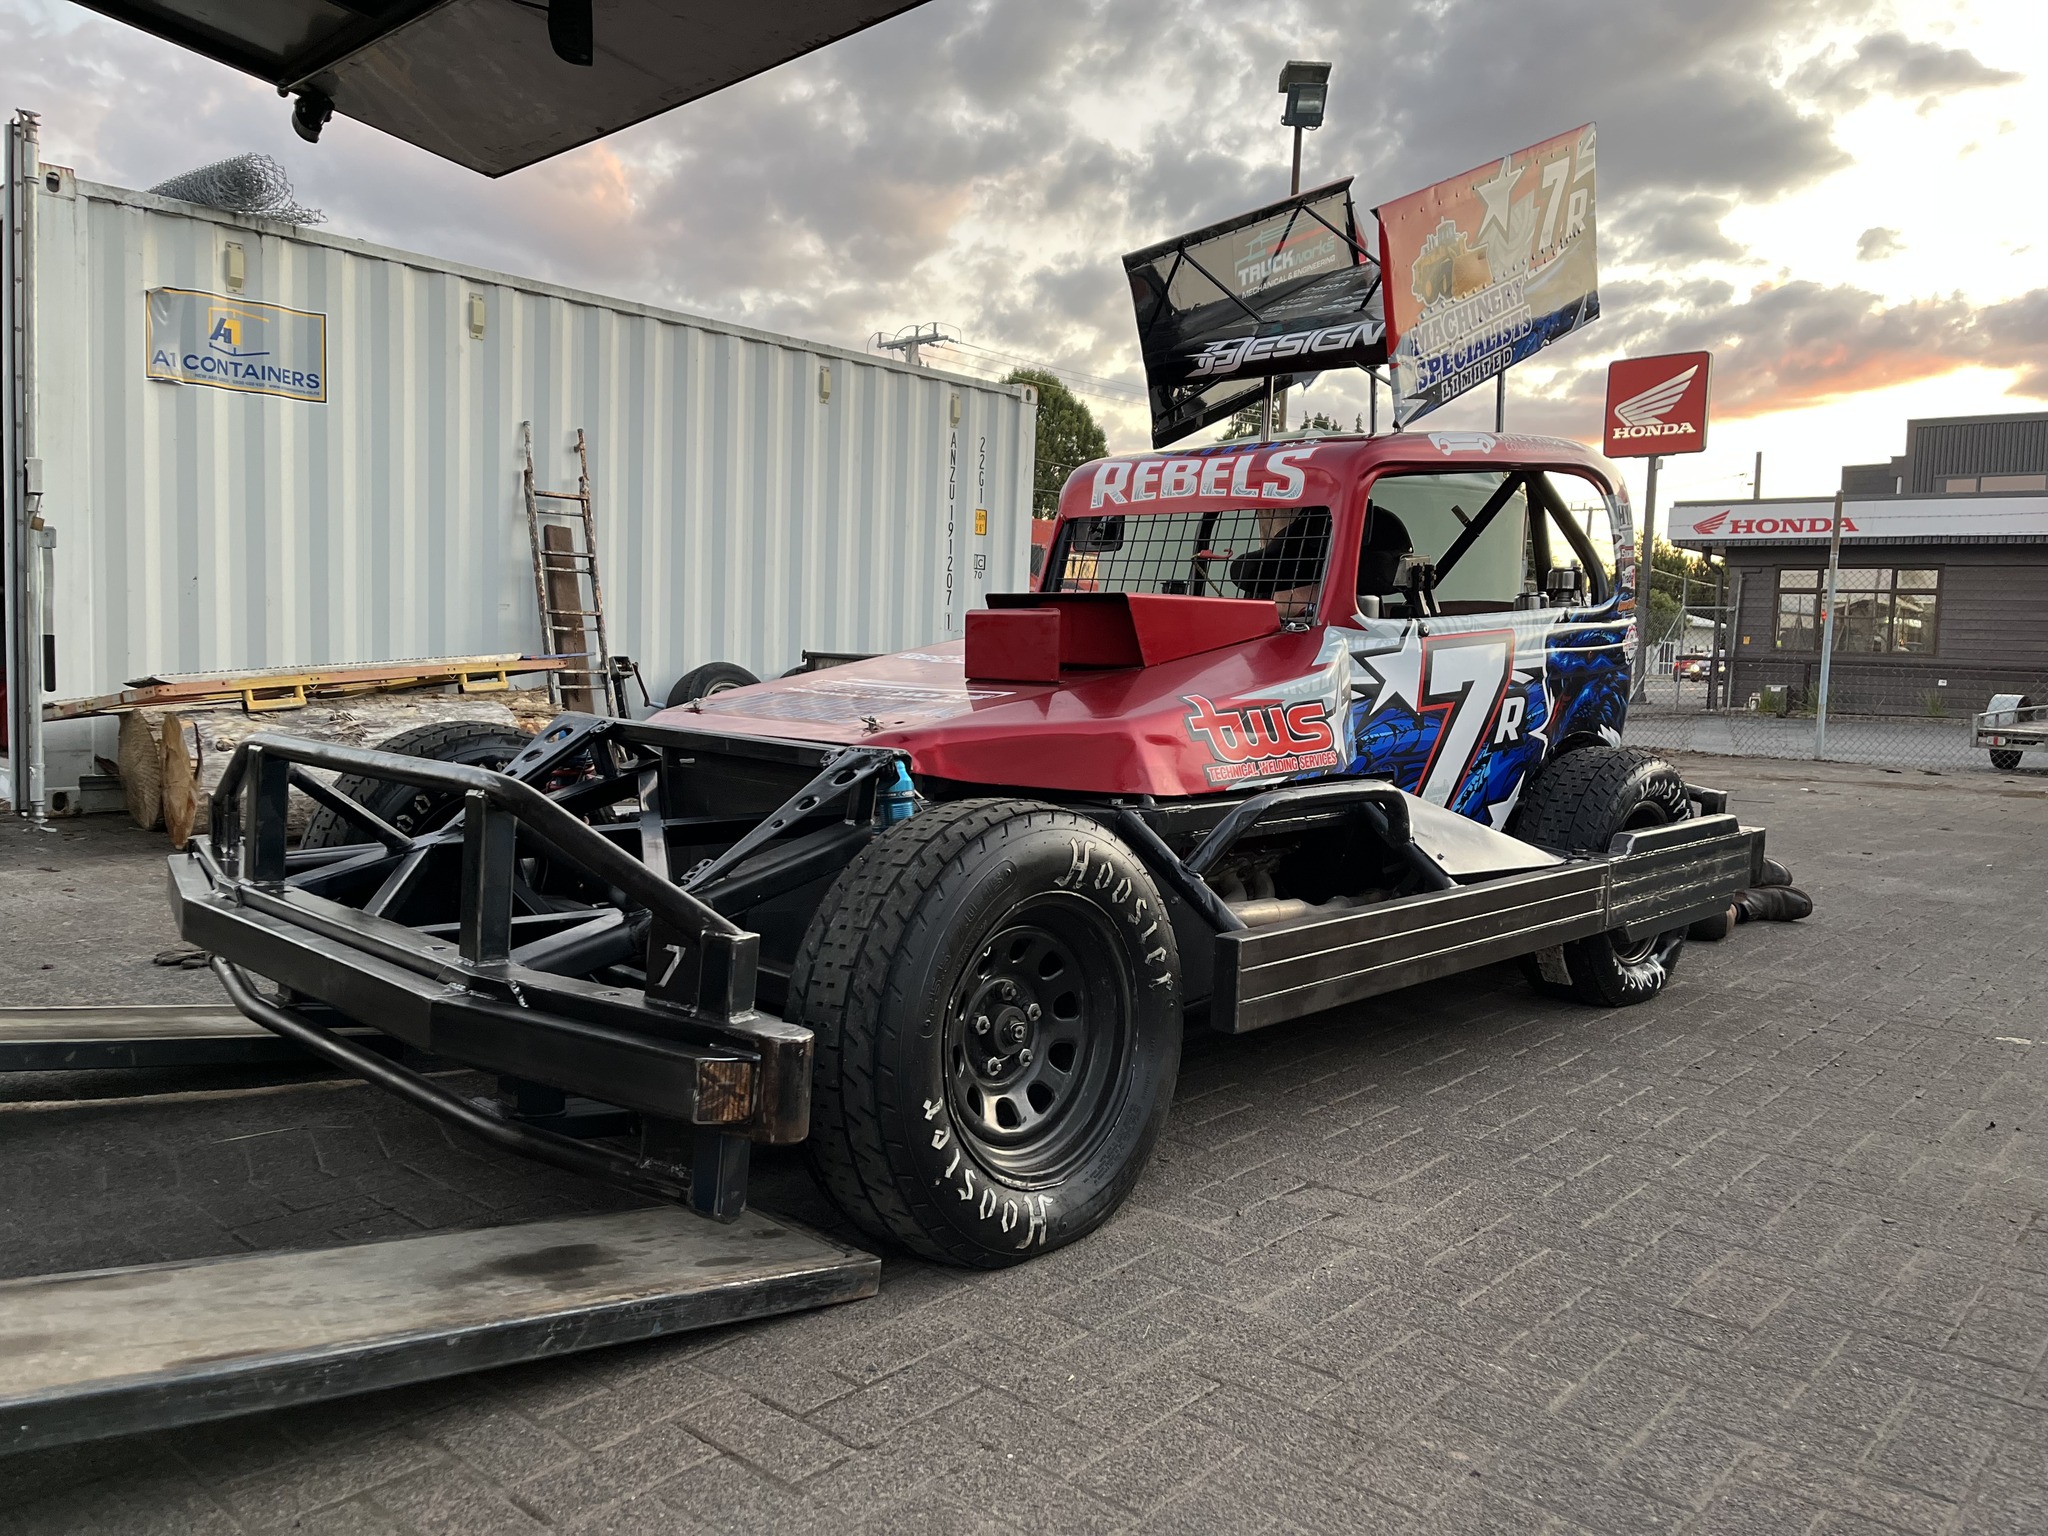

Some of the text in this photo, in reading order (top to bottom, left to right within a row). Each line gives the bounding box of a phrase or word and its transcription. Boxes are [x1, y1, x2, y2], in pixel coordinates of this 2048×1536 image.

[1539, 156, 1570, 249] 7
[1241, 276, 1288, 300] MECHANICAL
[1287, 272, 1294, 281] &
[1293, 254, 1336, 278] ENGINEERING
[1410, 275, 1525, 360] MACHINERY
[151, 349, 177, 368] A1
[183, 354, 321, 390] CONTAINERS
[1415, 304, 1533, 393] SPECIALISTS
[1441, 346, 1513, 402] LIMITED
[1612, 421, 1697, 440] HONDA
[978, 436, 987, 504] 22G1
[1090, 446, 1320, 510] REBELS
[1728, 517, 1860, 535] HONDA
[974, 570, 983, 580] 70
[1420, 640, 1525, 808] 7 R
[1207, 749, 1338, 783] TECHNICAL WELDING SERVICES
[655, 943, 687, 988] 7
